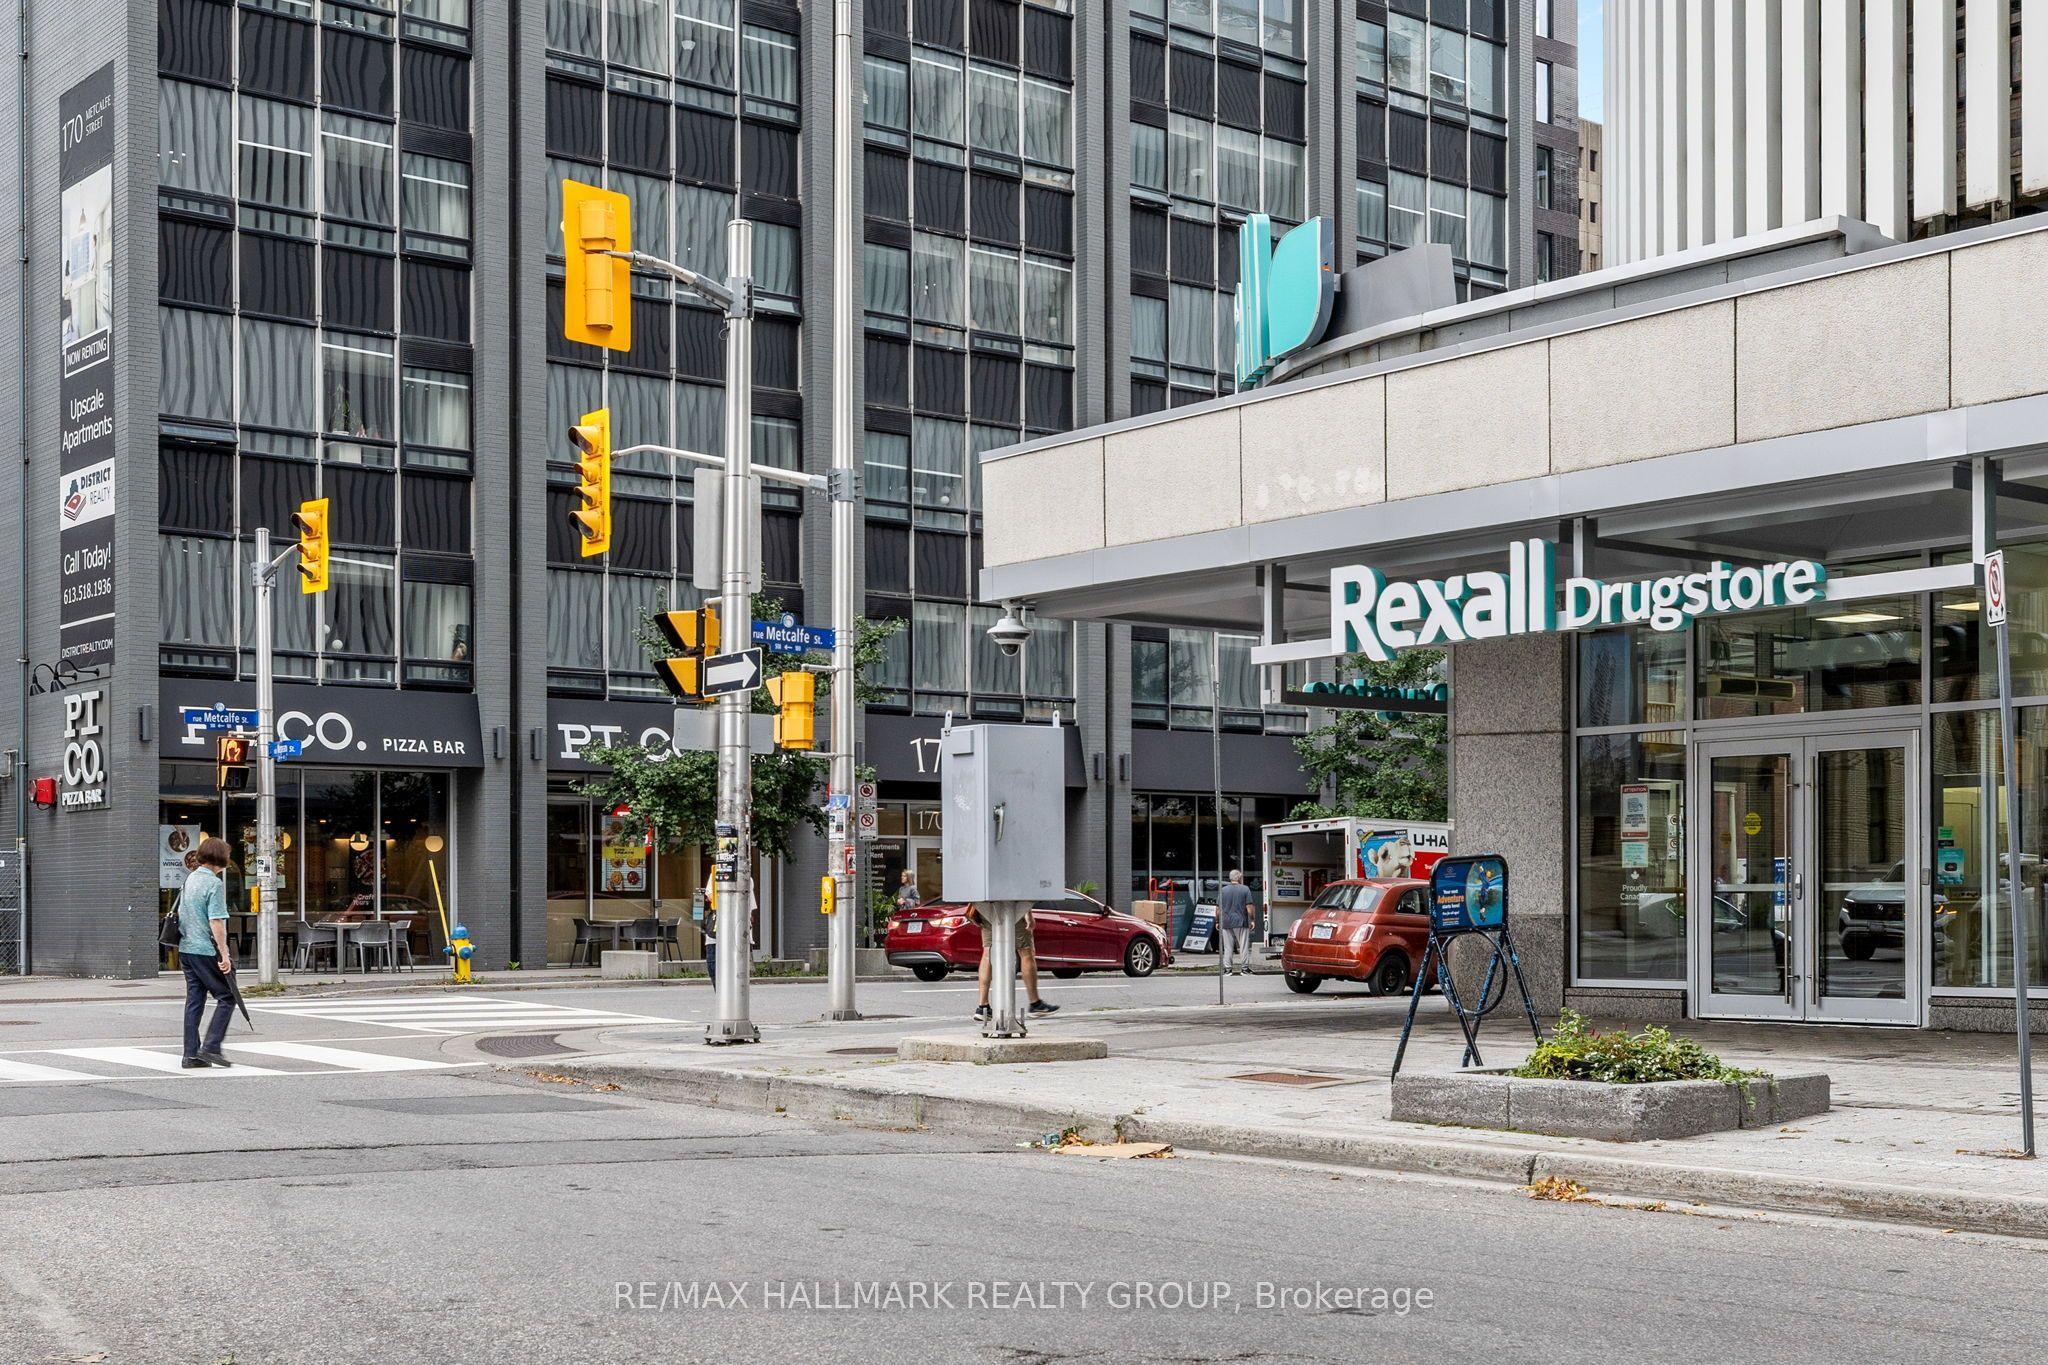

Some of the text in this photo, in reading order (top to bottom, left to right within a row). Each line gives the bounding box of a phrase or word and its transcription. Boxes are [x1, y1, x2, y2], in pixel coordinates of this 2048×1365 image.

[86, 94, 111, 121] METCALFE
[62, 114, 83, 152] 170
[86, 115, 103, 137] STREET
[67, 337, 107, 367] NOW RENTING
[70, 388, 104, 423] Upscale
[62, 415, 113, 454] Apartments
[81, 466, 111, 490] DISTRICT
[90, 486, 110, 505] REALTY
[63, 541, 111, 575] Call Today!
[63, 577, 112, 605] 613.518.1936
[1331, 538, 1825, 661] Rexall Drugstore
[61, 638, 114, 659] DISTRICTREALTY.COM
[752, 630, 764, 639] rue
[766, 626, 810, 644] Metcalfe
[64, 690, 101, 738] PI
[192, 715, 202, 723] rue
[203, 712, 240, 724] Metcalfe
[277, 710, 367, 751] CO.
[382, 738, 429, 753] PIZZA
[433, 740, 466, 755] BAR
[64, 739, 104, 786] CO.
[62, 788, 102, 806] PIZZA BAR
[870, 843, 900, 851] partments
[1622, 884, 1647, 892] Proudly
